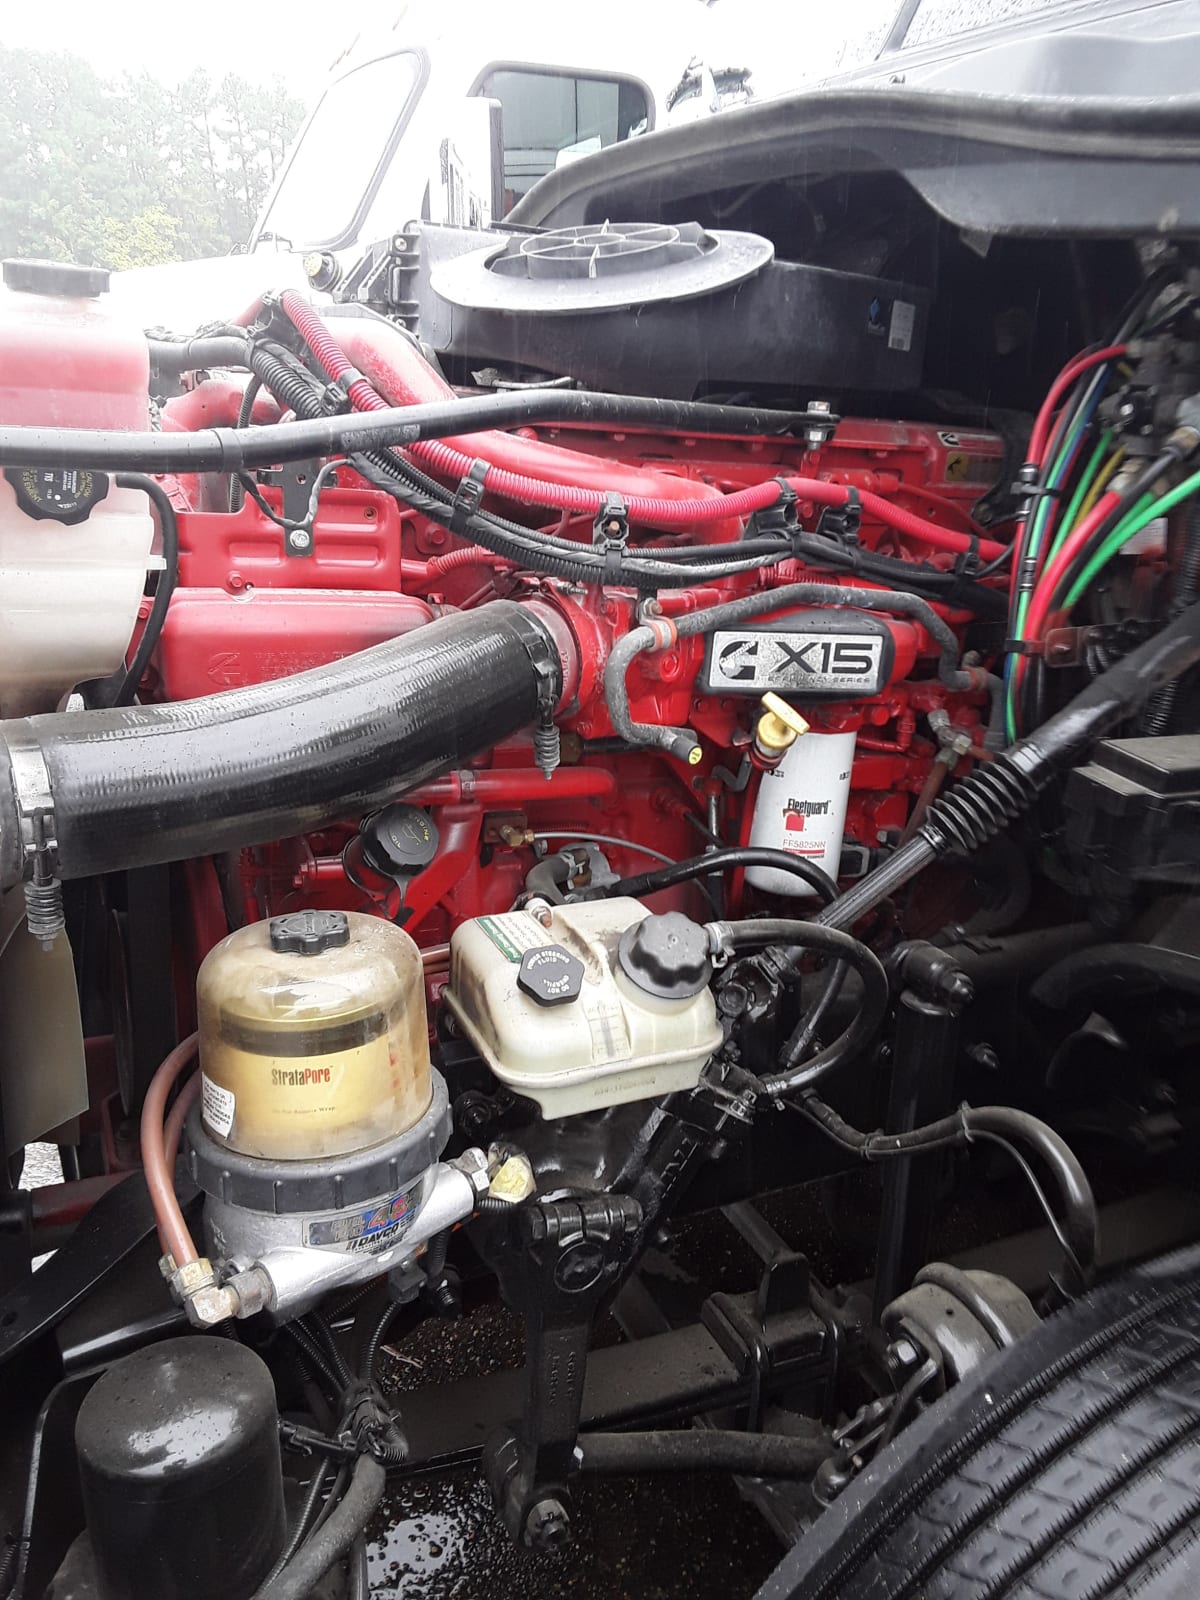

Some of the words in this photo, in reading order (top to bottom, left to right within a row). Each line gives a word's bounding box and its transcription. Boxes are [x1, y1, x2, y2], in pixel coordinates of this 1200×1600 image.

[22, 471, 43, 503] SSEMENT
[83, 472, 93, 498] CAUTION
[774, 641, 873, 674] X15
[788, 798, 829, 818] Fleetguard
[783, 839, 826, 849] FF5825NN
[527, 953, 541, 970] POWER
[540, 950, 570, 964] STEERING
[537, 956, 557, 966] FLUID
[561, 984, 570, 992] DO
[271, 1067, 331, 1086] StrataPore
[358, 1222, 400, 1247] DAVCO
